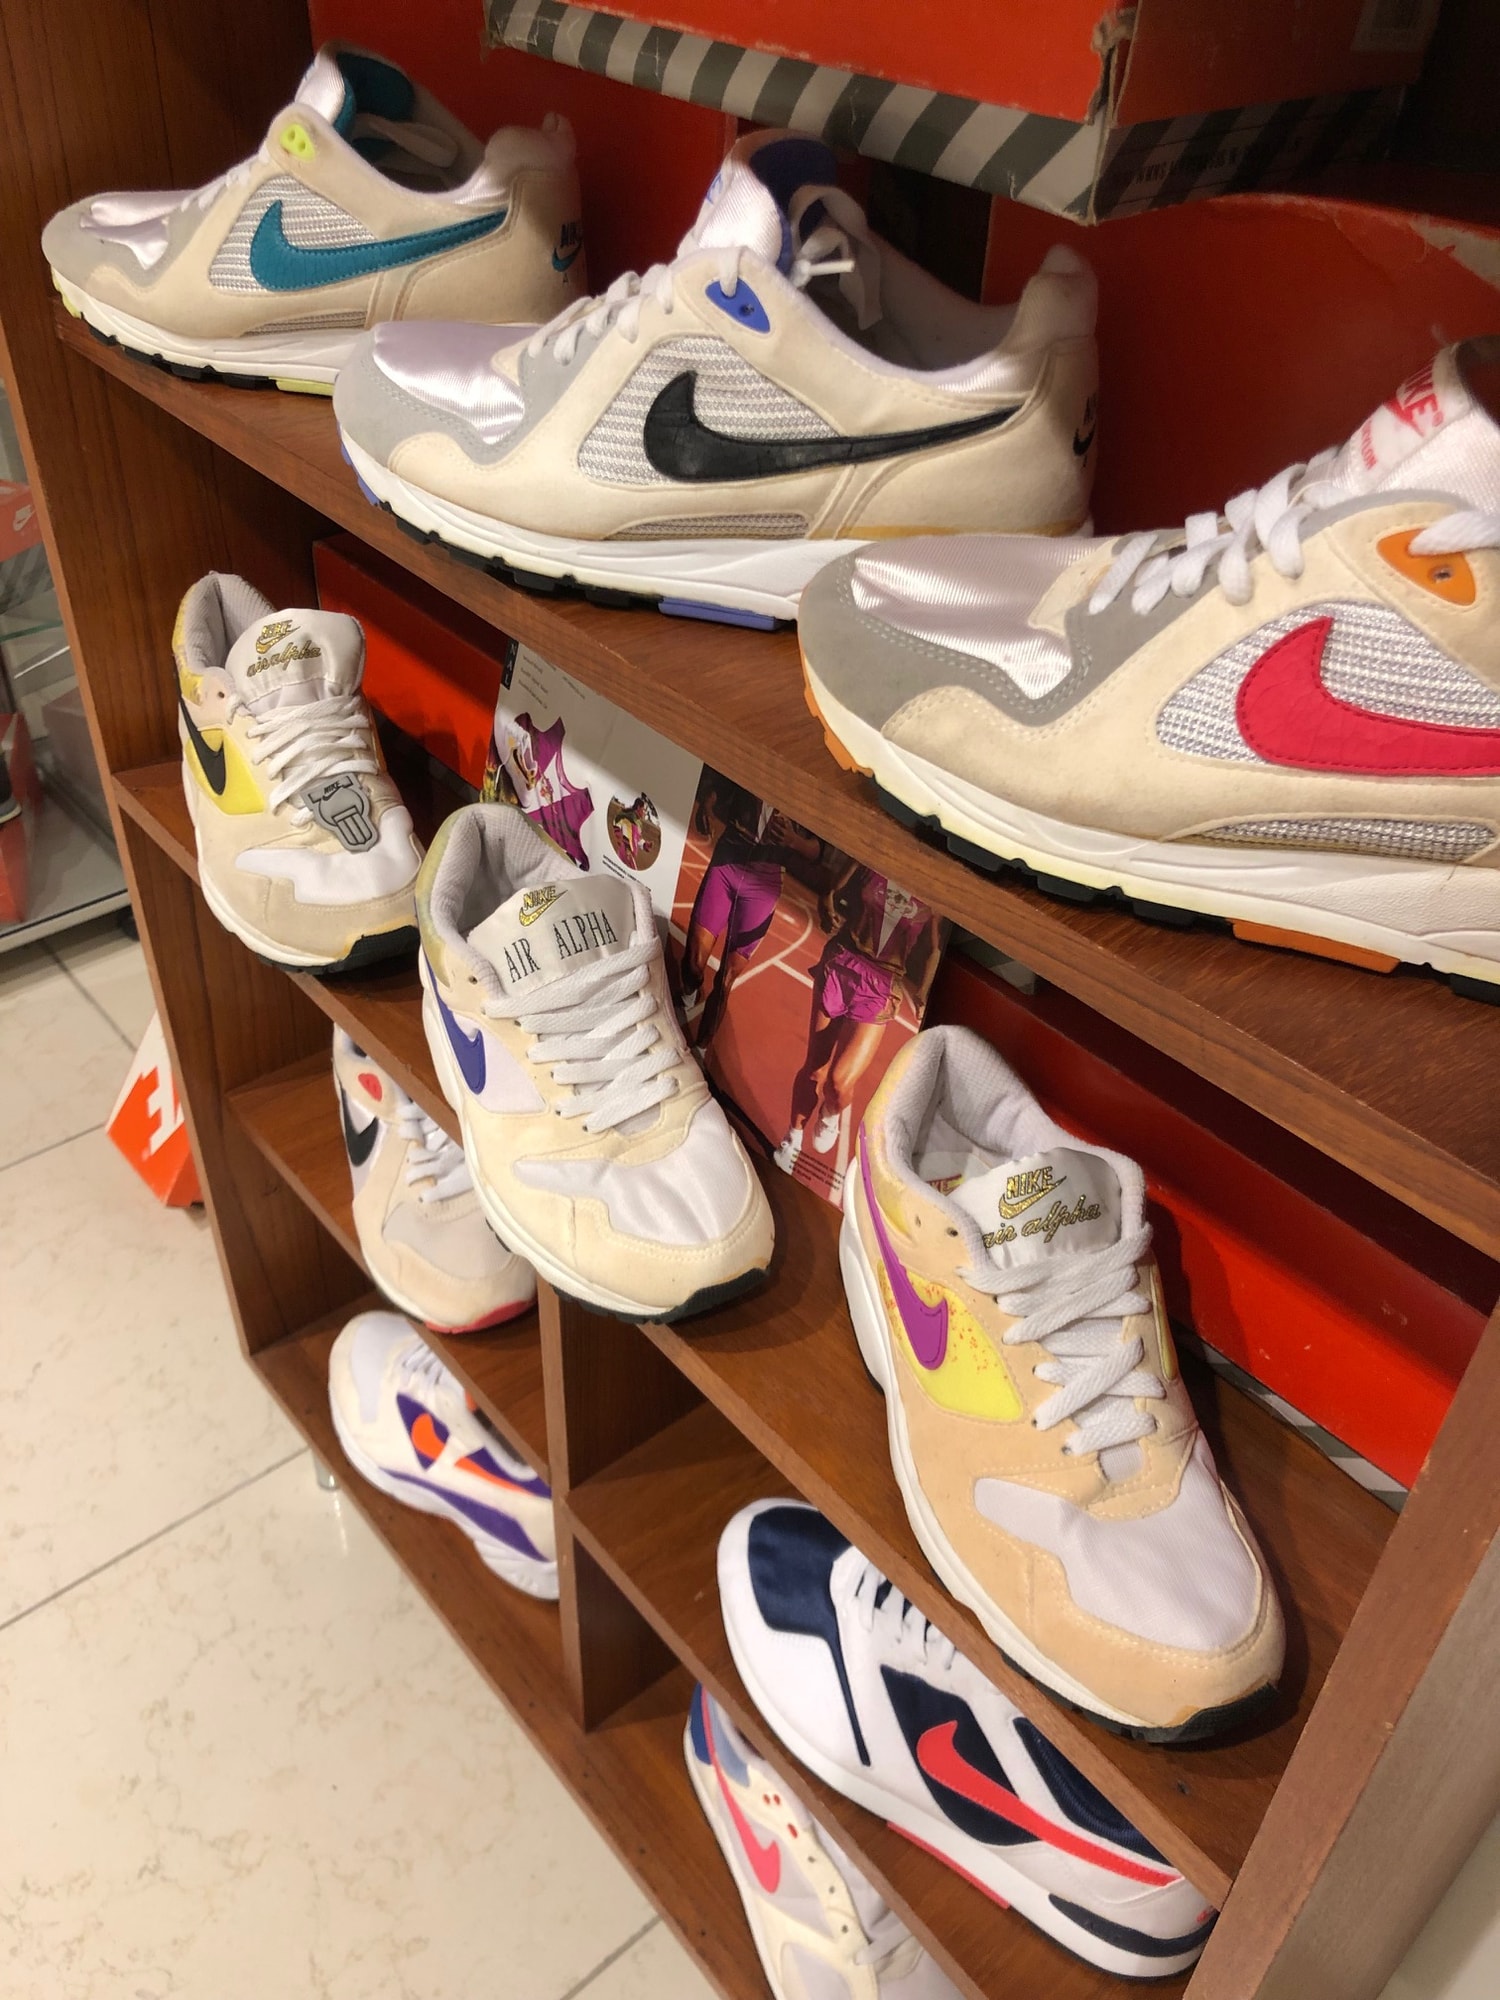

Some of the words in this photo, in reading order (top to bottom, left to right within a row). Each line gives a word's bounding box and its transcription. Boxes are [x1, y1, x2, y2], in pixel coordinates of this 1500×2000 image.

[523, 885, 558, 911] NIKE
[503, 937, 541, 983] AIR
[552, 908, 618, 960] ALPHA
[1006, 1166, 1054, 1200] NIKE
[1021, 1193, 1101, 1243] alpha
